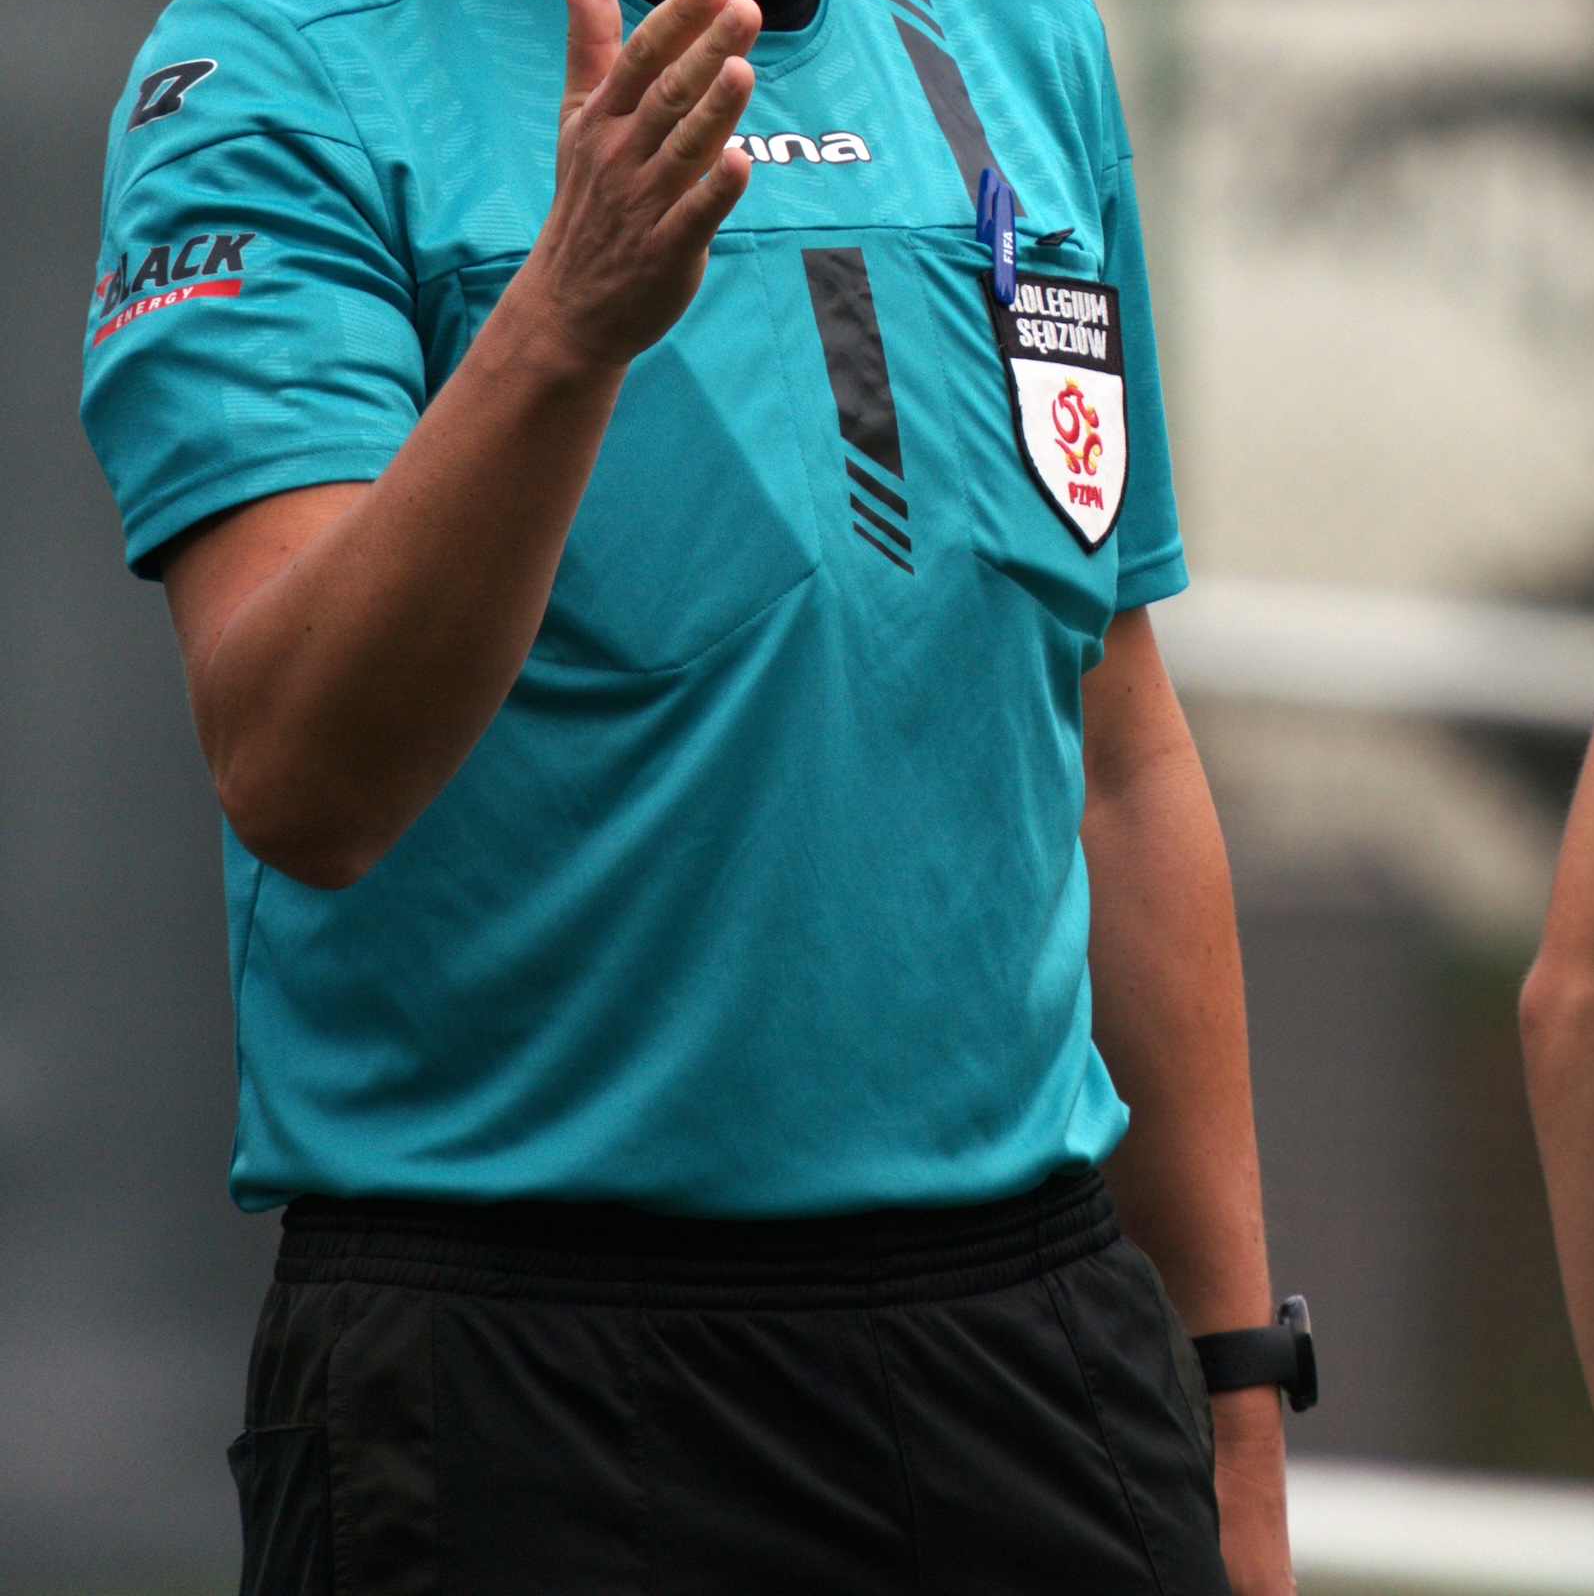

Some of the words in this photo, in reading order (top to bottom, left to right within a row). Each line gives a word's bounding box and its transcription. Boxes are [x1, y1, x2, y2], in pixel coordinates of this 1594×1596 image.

[1003, 231, 1014, 265] FIFA
[99, 232, 257, 320] BLACK
[115, 286, 195, 330] ENERGY
[1016, 317, 1107, 361] SĘDZIÓW
[1067, 481, 1104, 511] PZPN
